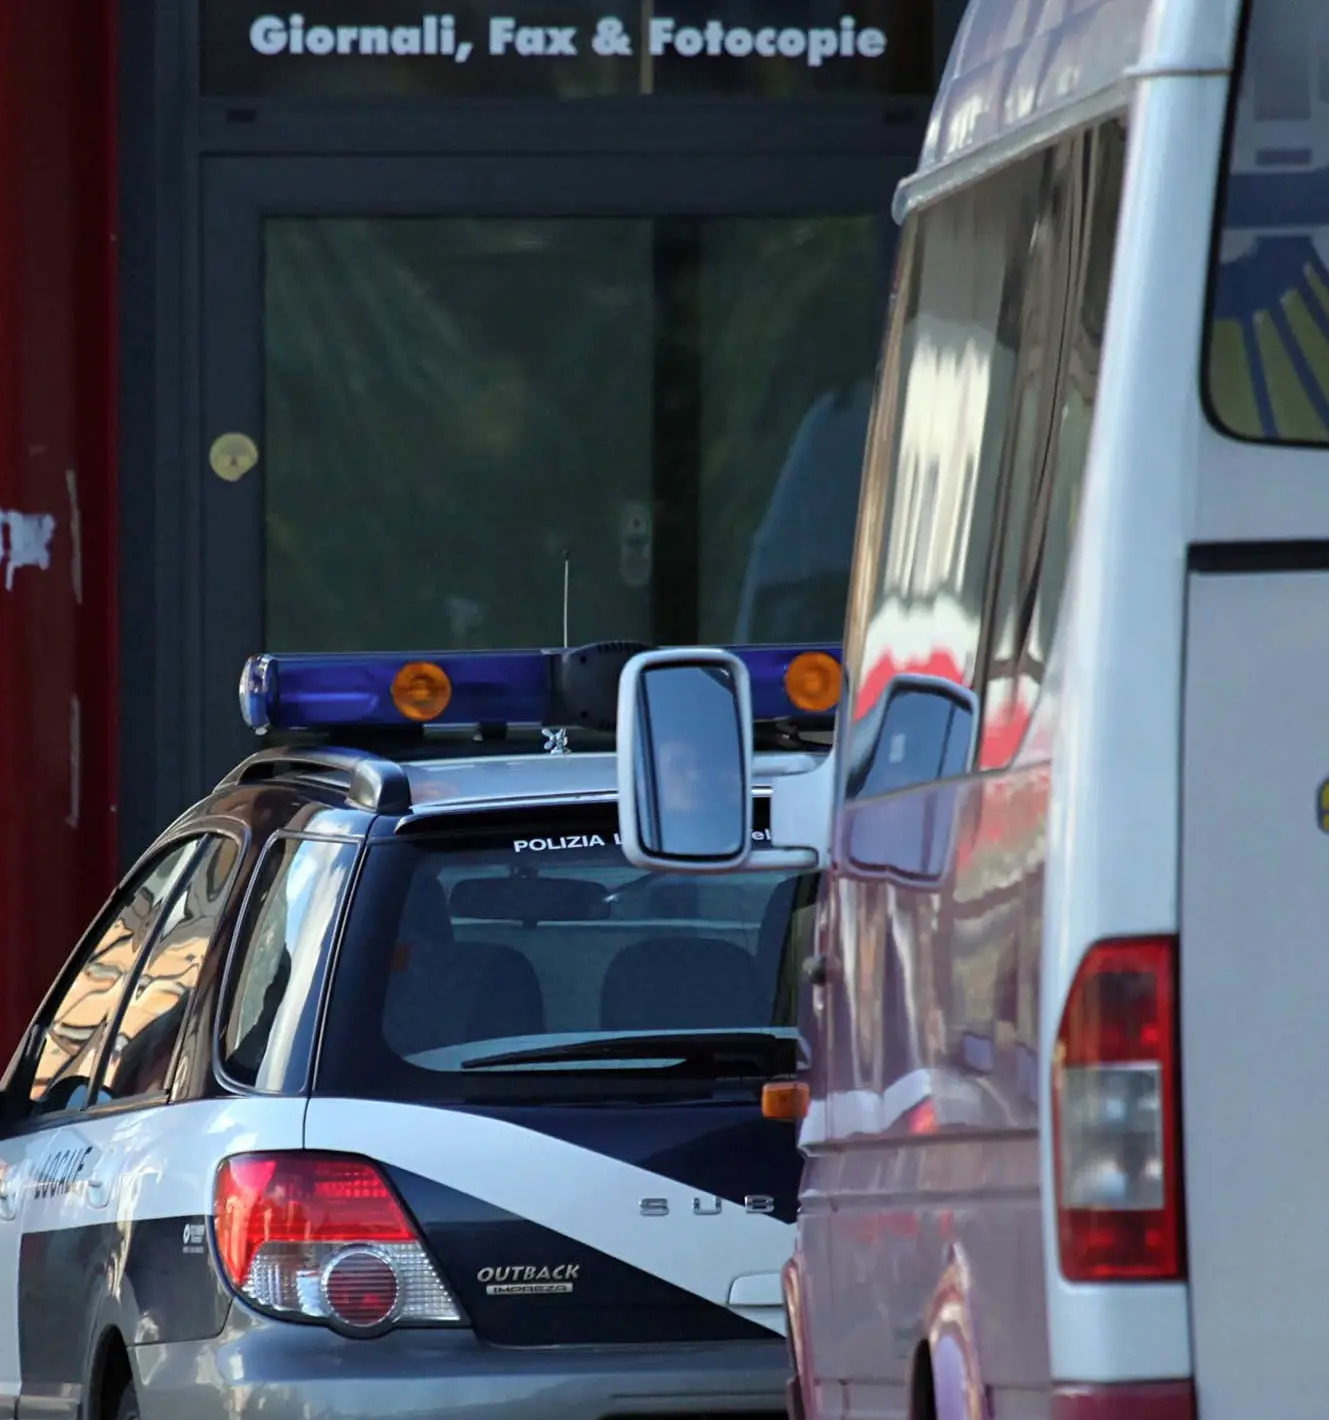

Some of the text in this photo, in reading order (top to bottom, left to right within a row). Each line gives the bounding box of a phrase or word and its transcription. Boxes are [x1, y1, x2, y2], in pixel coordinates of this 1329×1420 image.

[249, 14, 887, 66] Giornali, Fax & Fotocopie
[513, 834, 605, 853] POLIZIA
[638, 1195, 776, 1216] SUB
[476, 1263, 581, 1283] OUTBACK
[491, 1284, 569, 1294] IMPREZA
